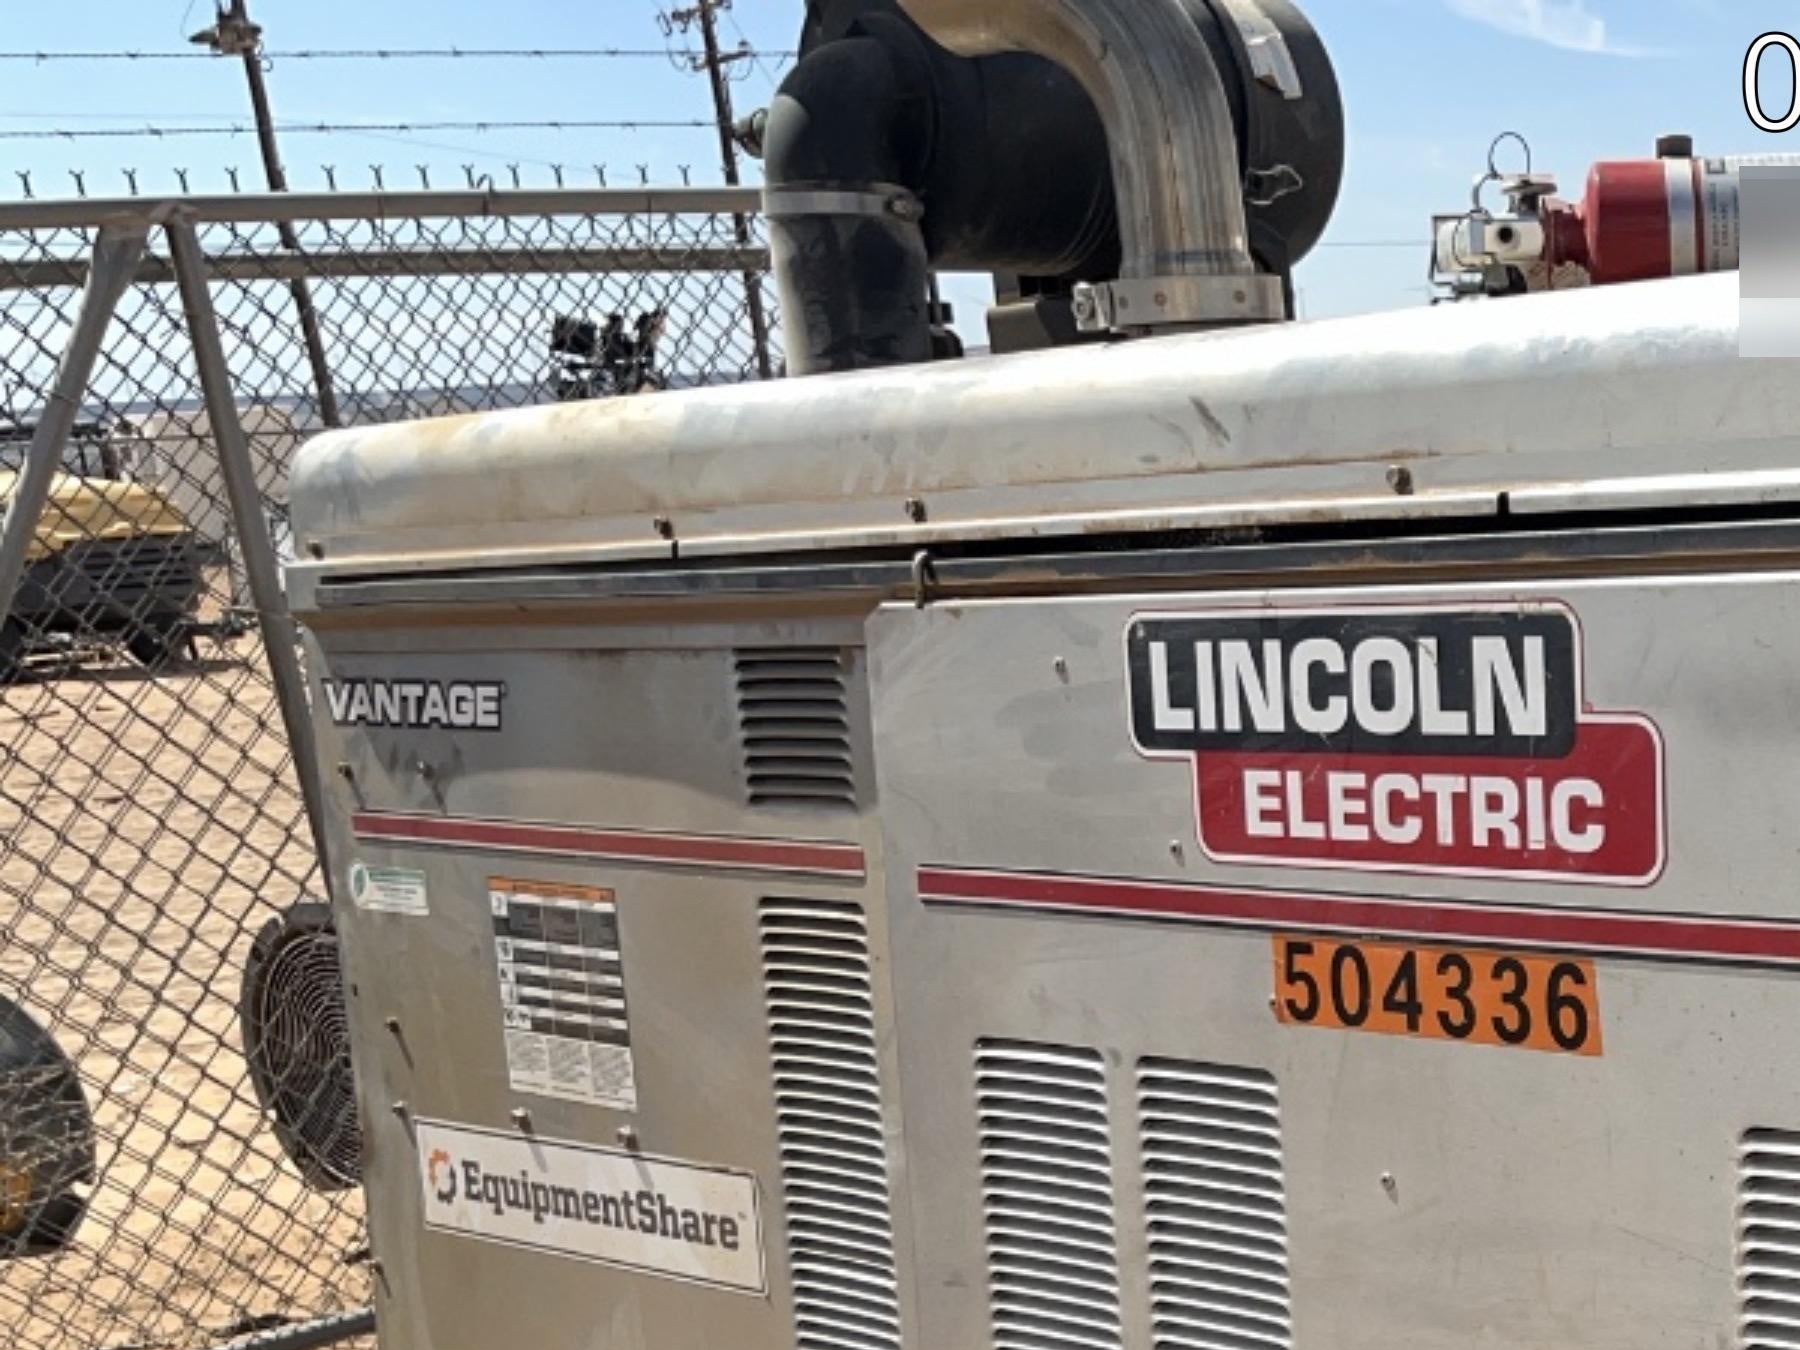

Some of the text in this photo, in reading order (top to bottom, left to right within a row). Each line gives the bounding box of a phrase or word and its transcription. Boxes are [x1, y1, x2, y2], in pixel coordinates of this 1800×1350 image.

[323, 682, 500, 730] VANTAGE
[1147, 634, 1548, 737] LINCOLN
[1242, 768, 1606, 854] ELECTRIC
[1282, 940, 1590, 1052] 504336
[461, 1157, 740, 1252] EquipmentShare
